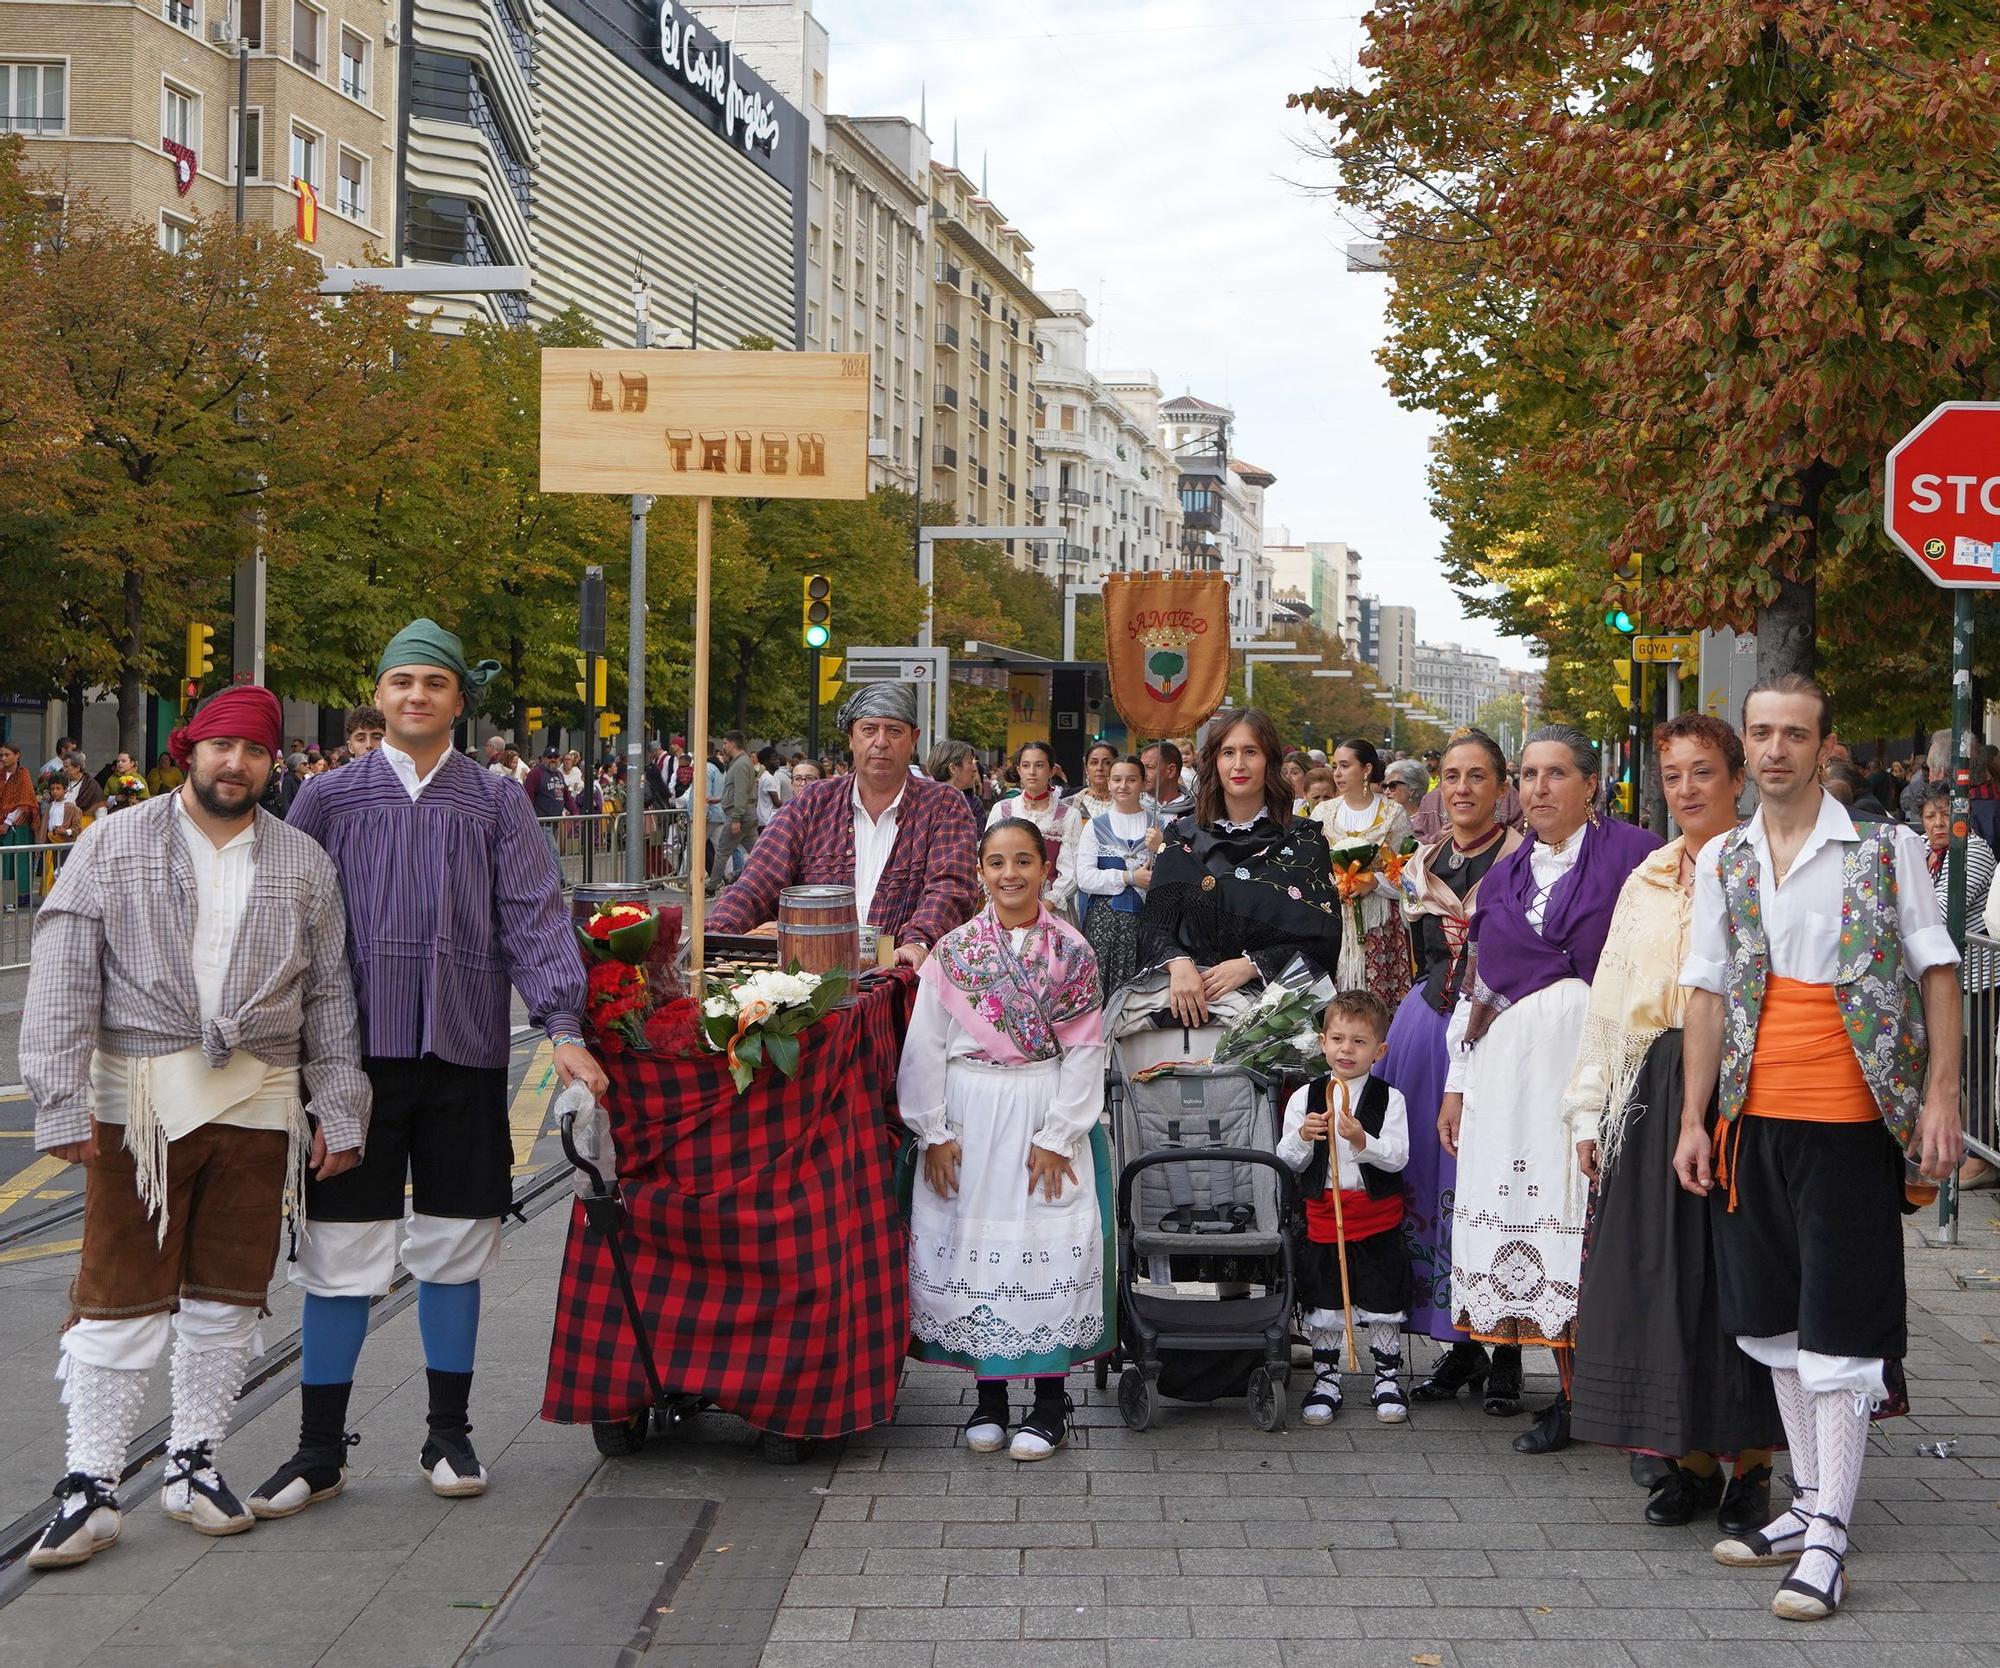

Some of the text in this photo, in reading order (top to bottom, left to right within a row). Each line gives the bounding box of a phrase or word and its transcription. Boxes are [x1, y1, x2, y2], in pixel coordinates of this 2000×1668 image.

[660, 0, 779, 150] El Corte Inglés
[841, 358, 866, 377] 2024
[588, 369, 648, 413] LA
[665, 428, 826, 476] TRIBU
[1638, 643, 1668, 655] GOYA
